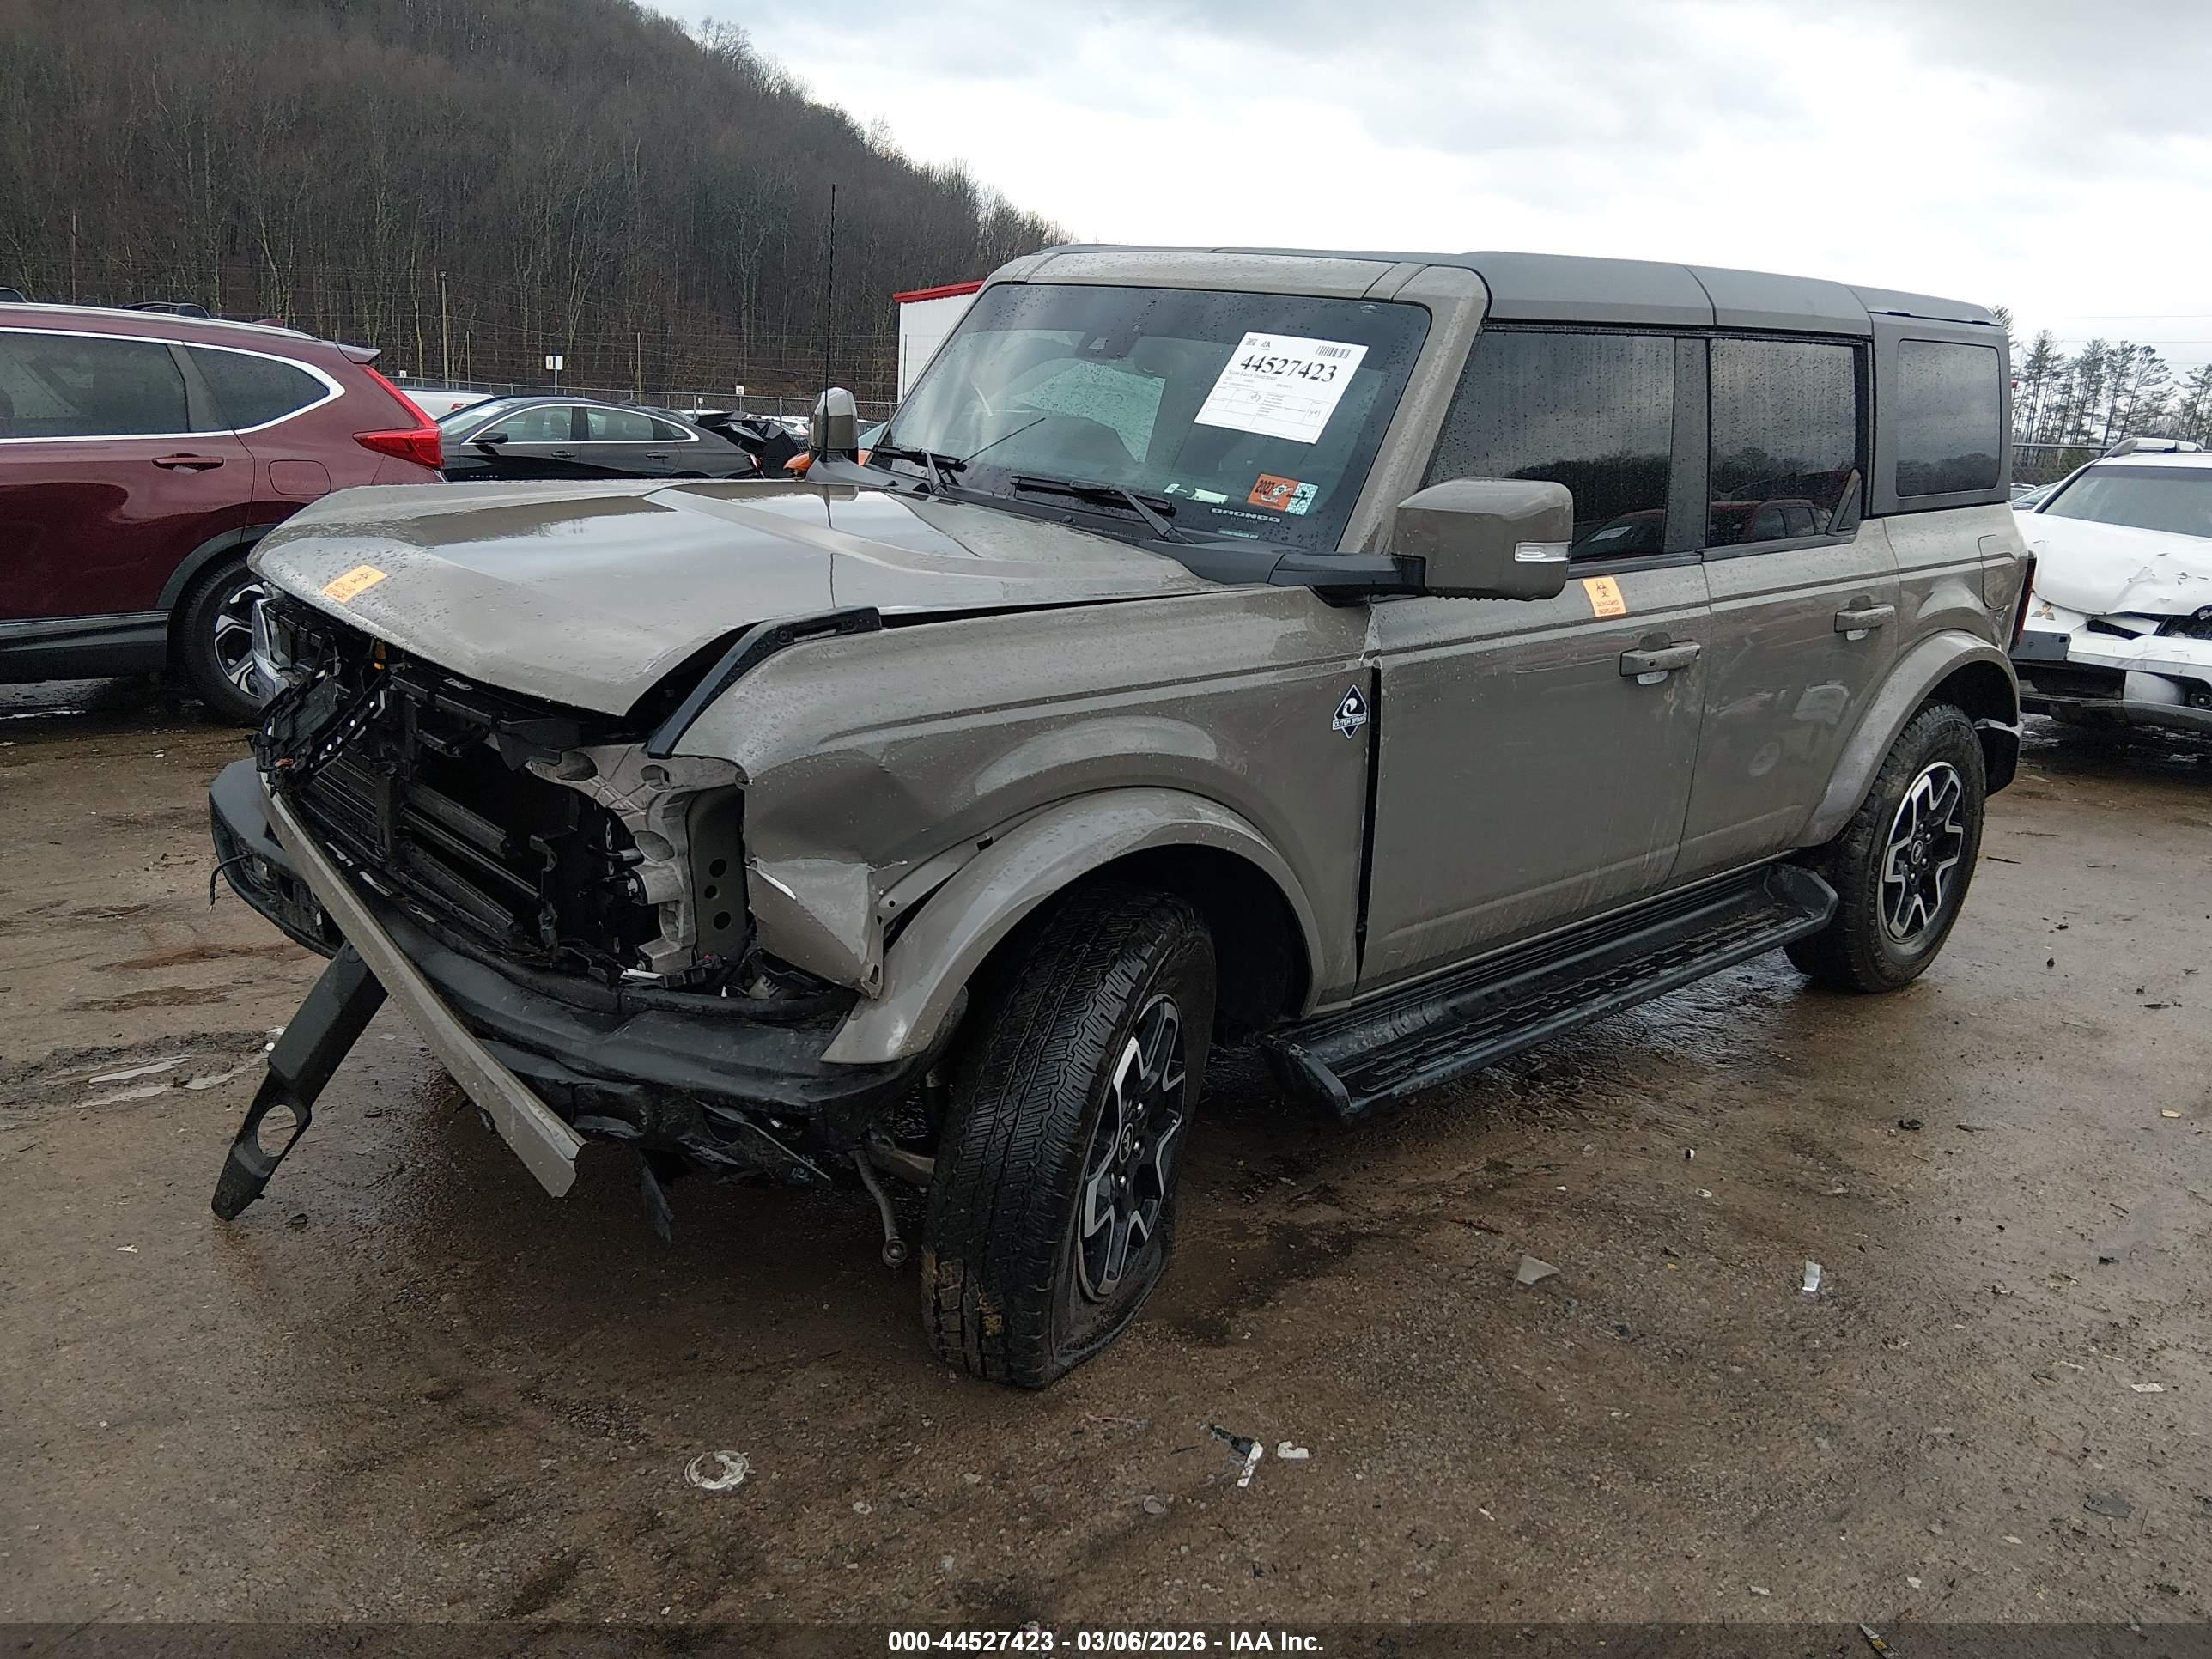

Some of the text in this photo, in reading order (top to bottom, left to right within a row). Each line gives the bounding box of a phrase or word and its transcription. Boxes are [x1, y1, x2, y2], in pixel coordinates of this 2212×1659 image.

[1240, 354, 1337, 383] 44527423
[1255, 479, 1276, 495] 2027
[1212, 508, 1280, 523] BRONCO
[1334, 715, 1366, 728] OUTER BANKS
